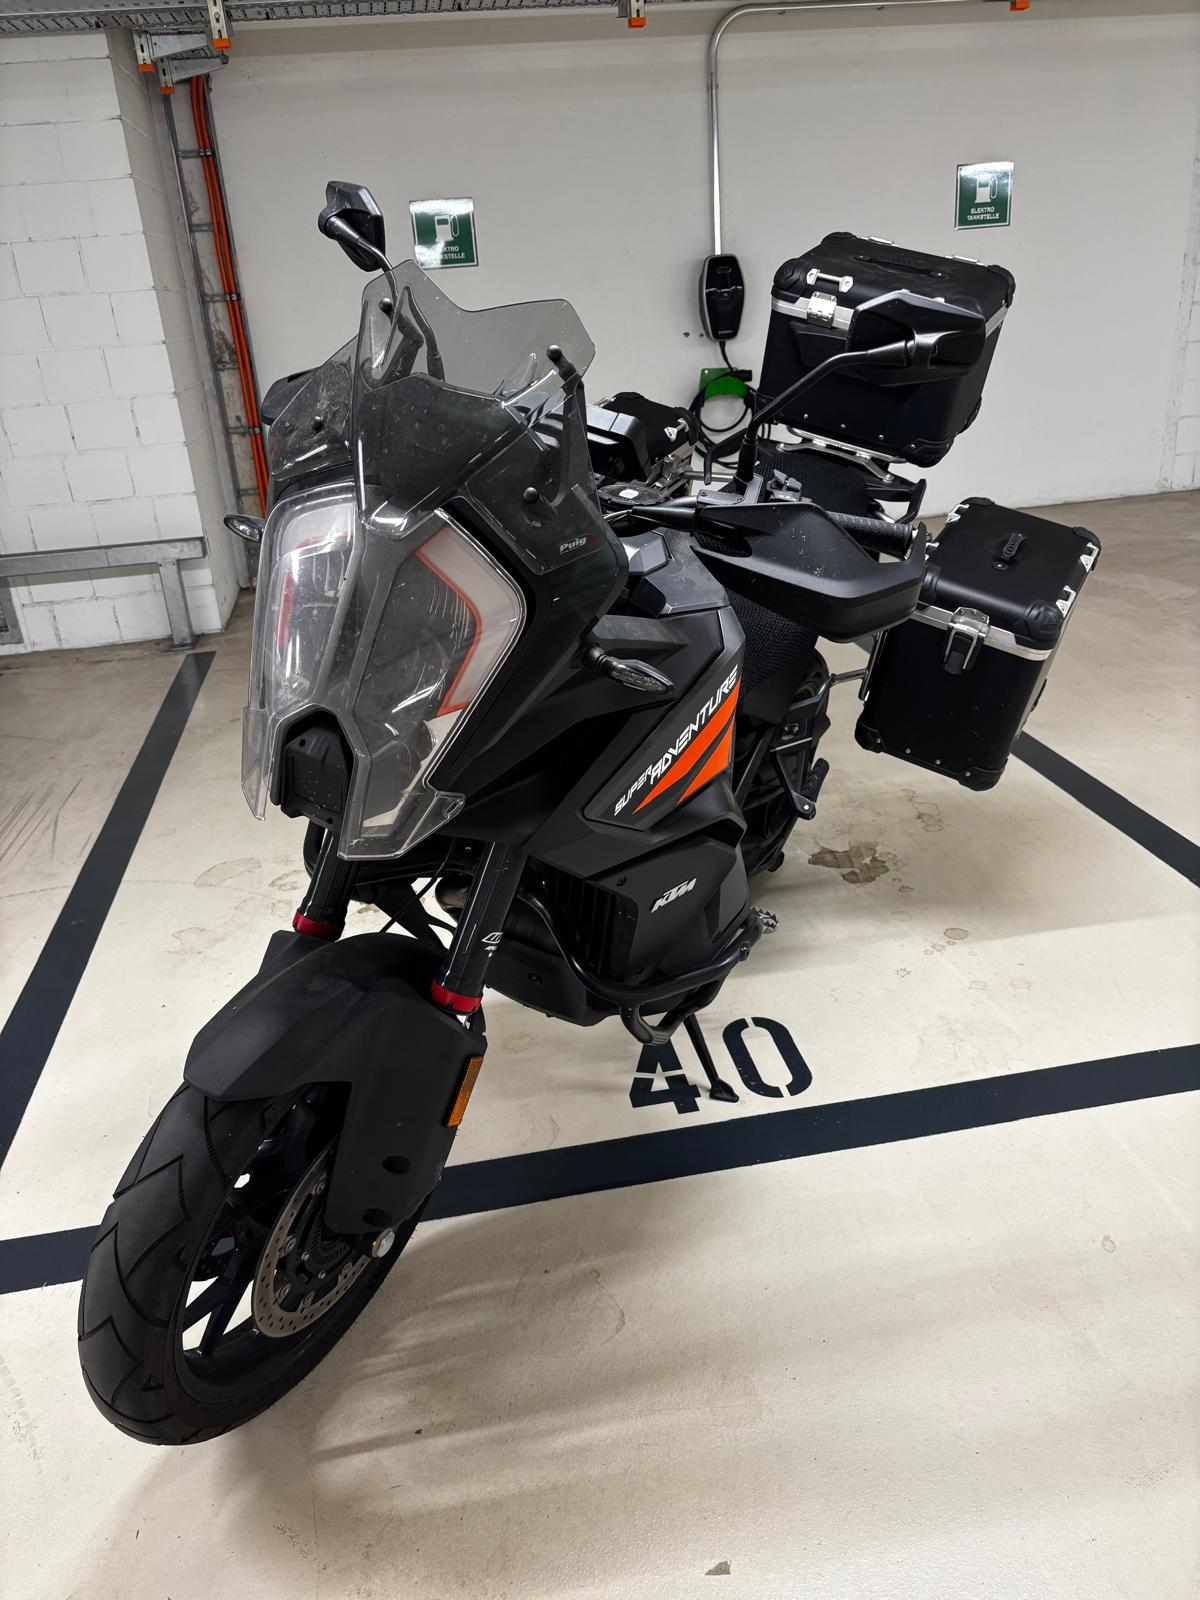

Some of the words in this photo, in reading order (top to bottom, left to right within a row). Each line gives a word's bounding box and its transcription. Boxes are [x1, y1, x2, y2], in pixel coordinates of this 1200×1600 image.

[967, 213, 1000, 221] TANKSTELLE
[970, 206, 995, 214] ELEKTRO
[559, 537, 587, 551] Puig
[614, 764, 652, 816] SUPER
[650, 664, 738, 785] ADVENTURE
[650, 878, 697, 914] KTM
[629, 1016, 813, 1115] 40
